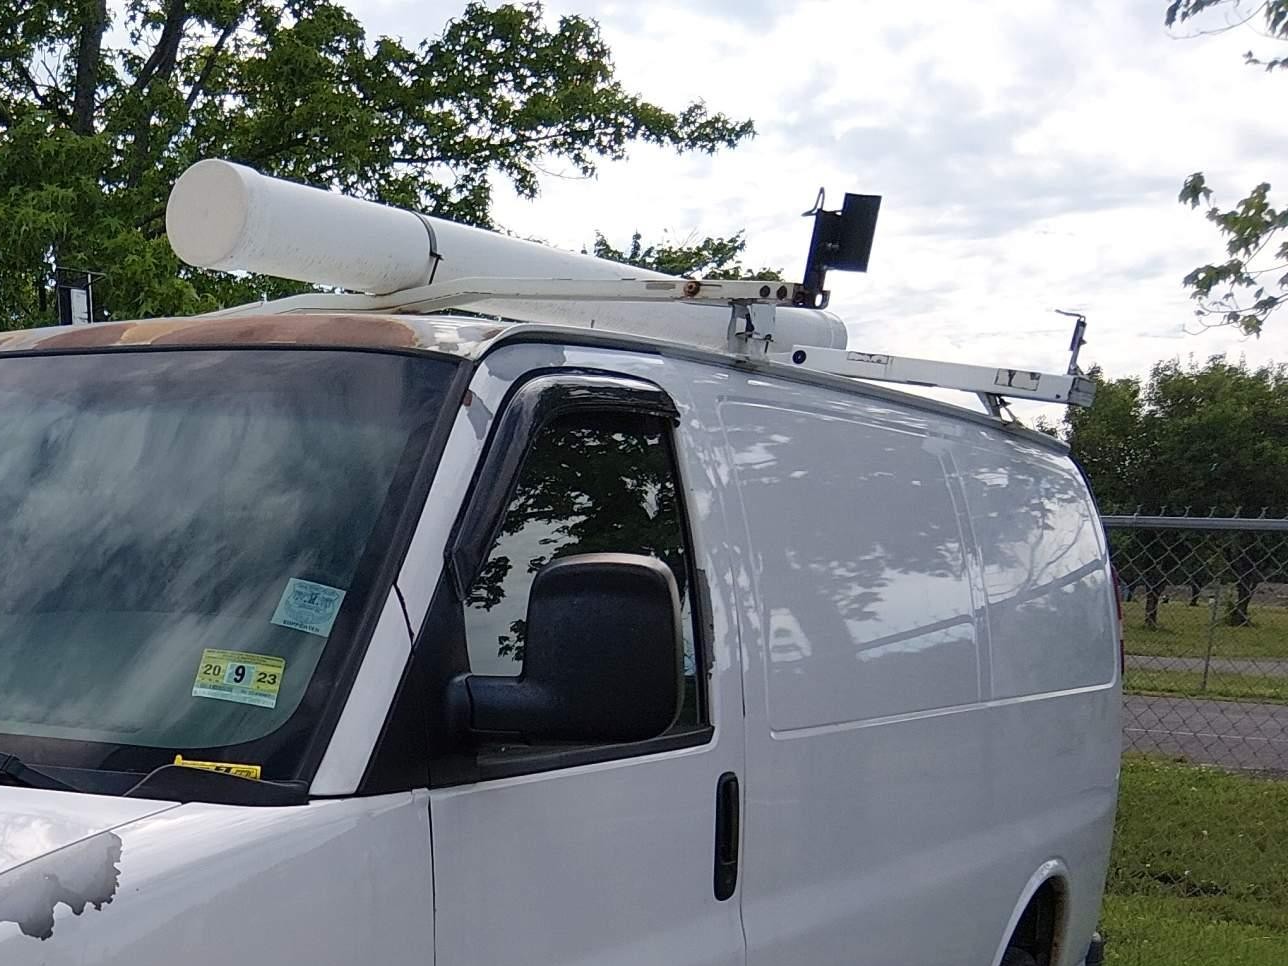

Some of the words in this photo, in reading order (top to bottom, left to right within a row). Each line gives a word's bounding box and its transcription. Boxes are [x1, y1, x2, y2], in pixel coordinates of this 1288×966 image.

[203, 663, 222, 677] 20
[233, 665, 246, 684] 9
[257, 672, 277, 685] 23
